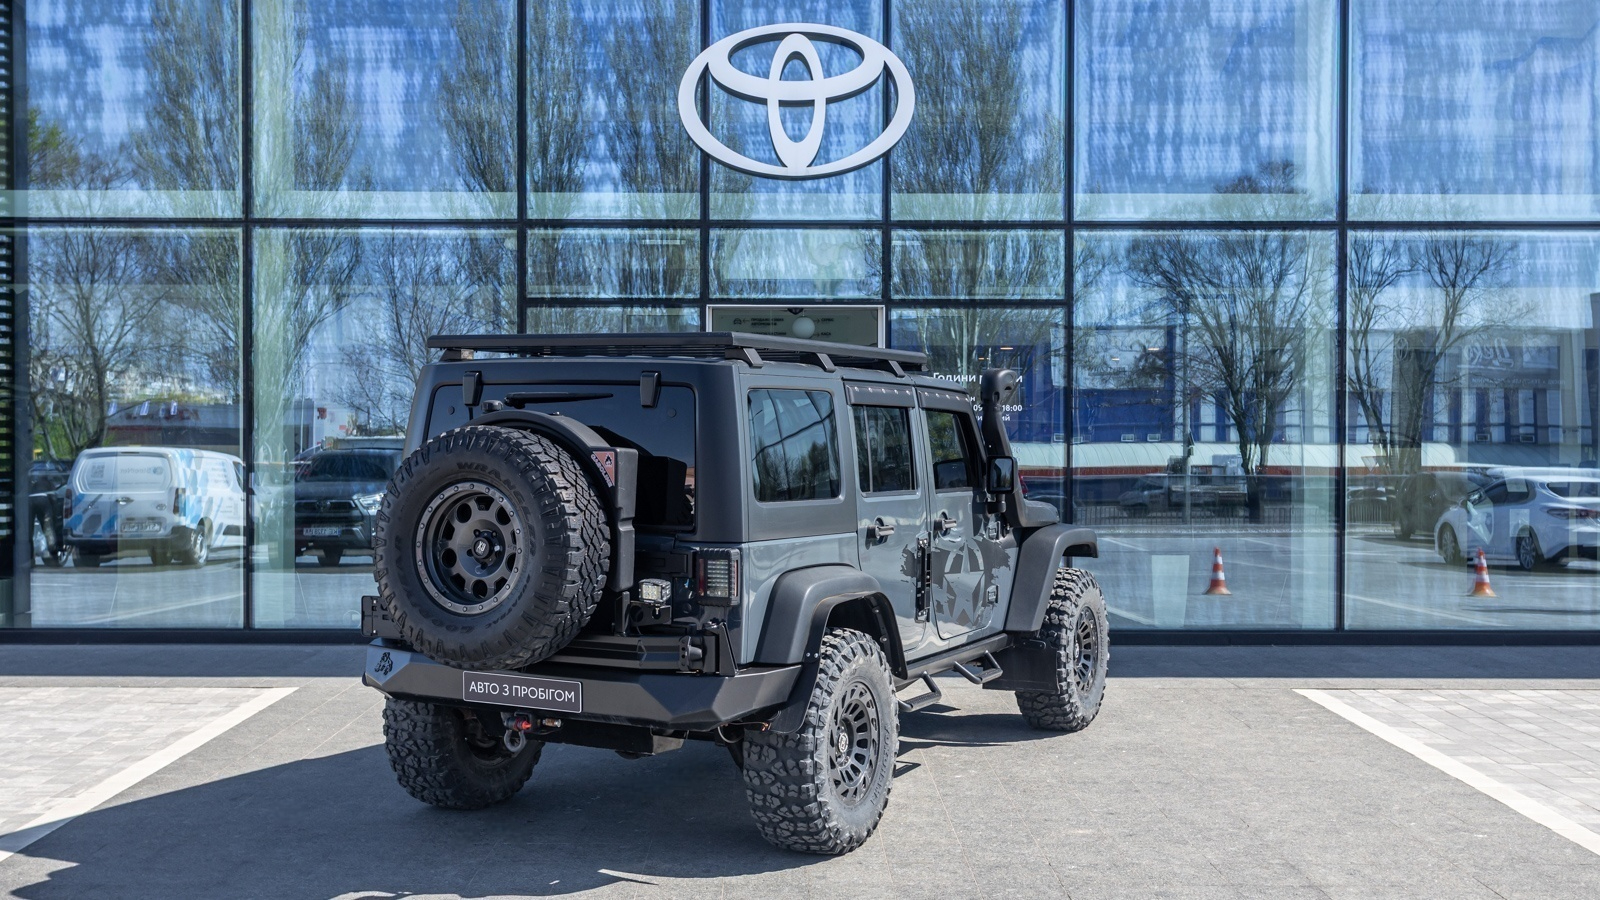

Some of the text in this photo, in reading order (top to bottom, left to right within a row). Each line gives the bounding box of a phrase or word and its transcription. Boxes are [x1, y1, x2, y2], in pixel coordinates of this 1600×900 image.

[1002, 404, 1023, 412] 18:00
[456, 461, 537, 558] WRANGLER
[469, 681, 575, 703] АВТО З ПРОБІГОМ
